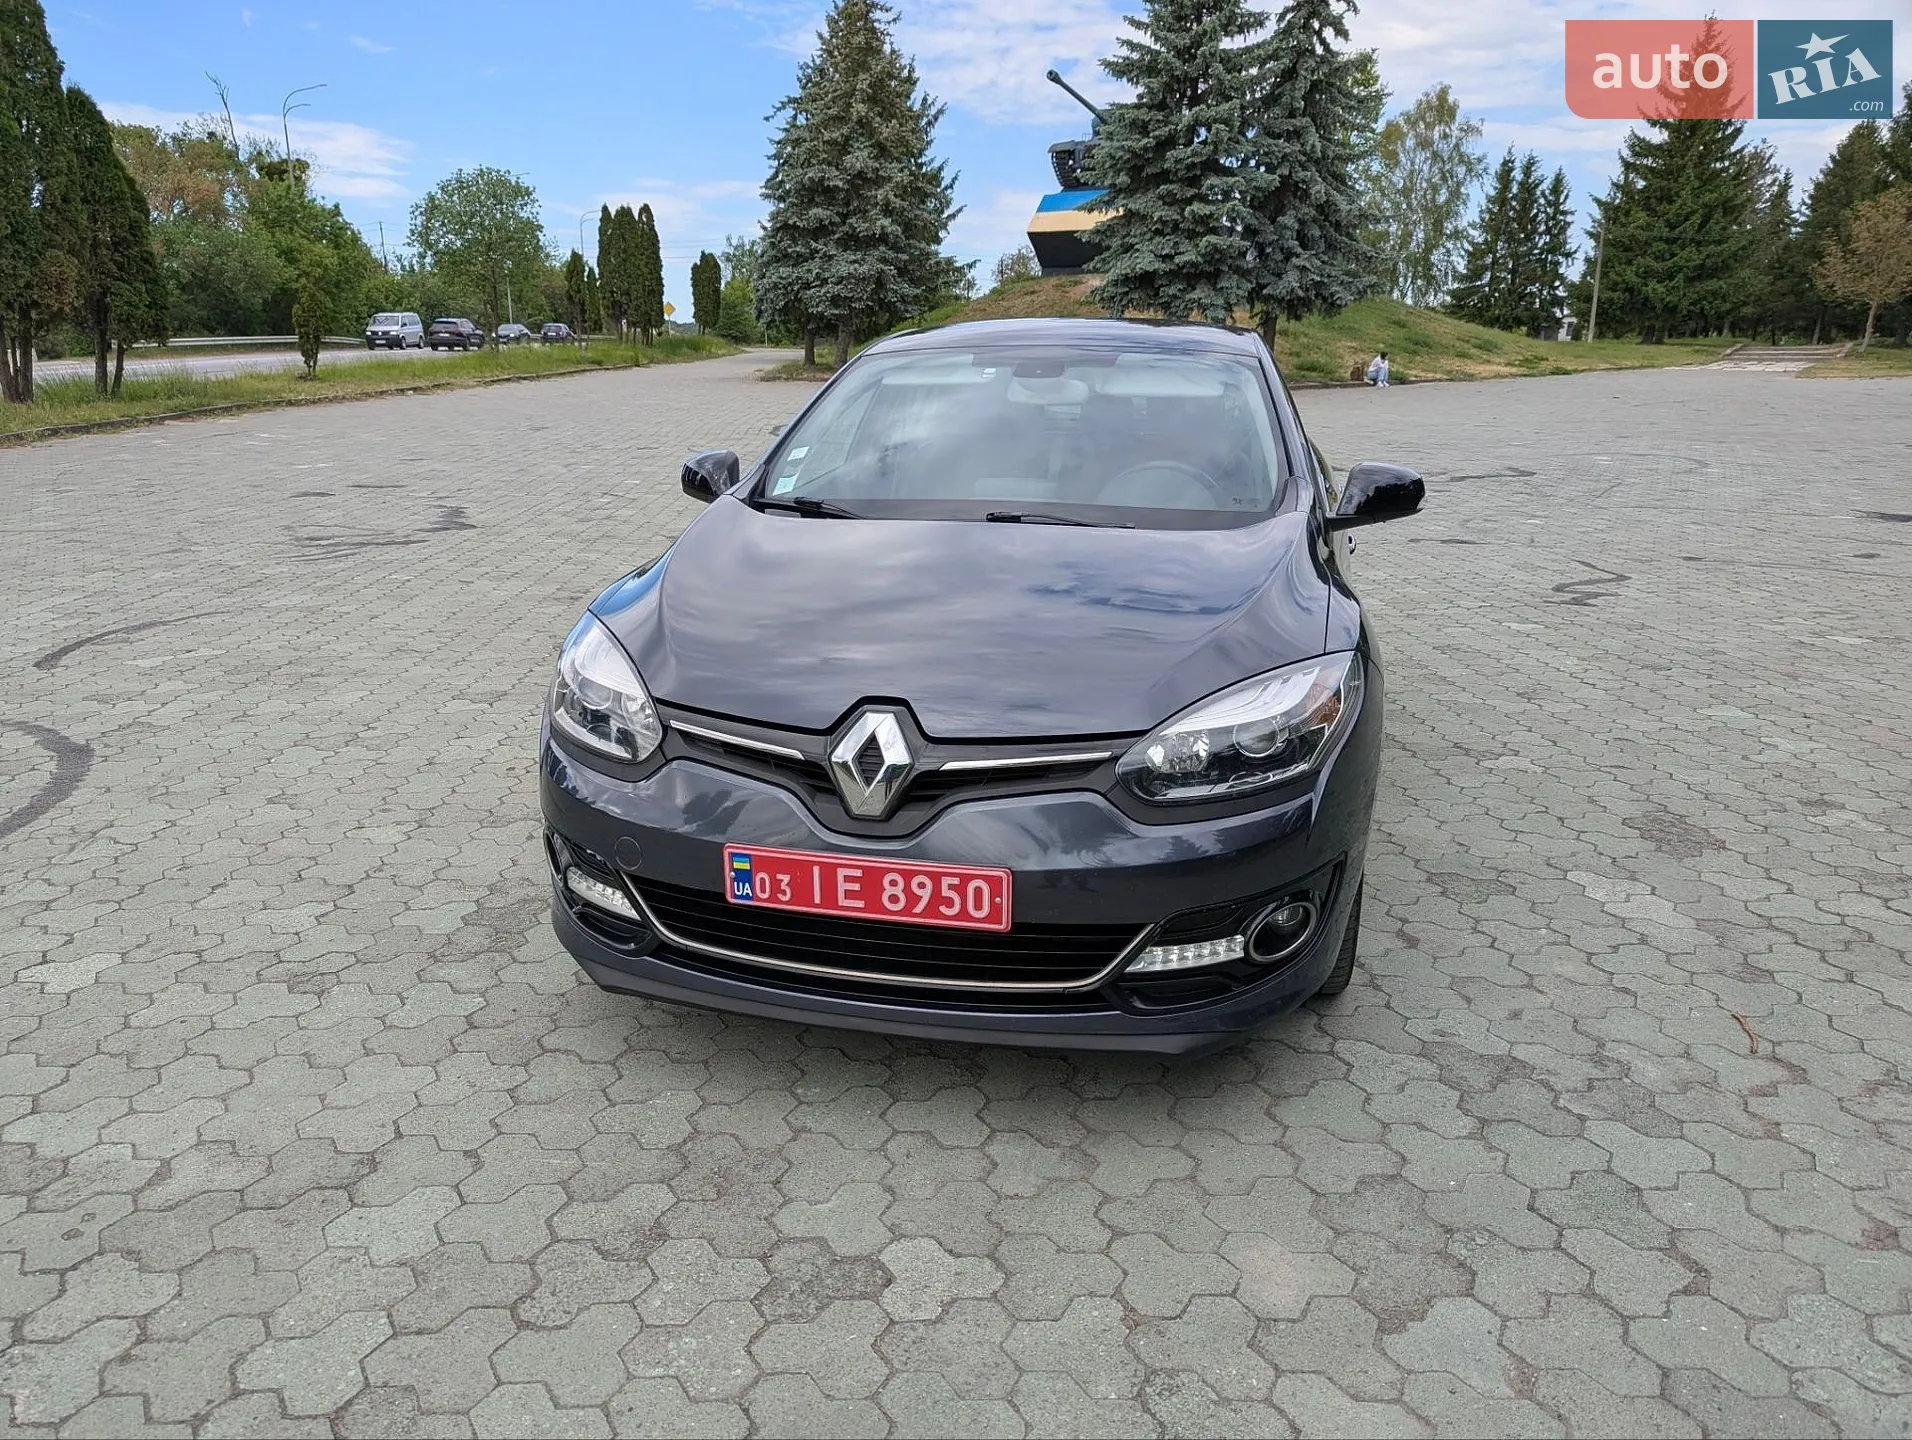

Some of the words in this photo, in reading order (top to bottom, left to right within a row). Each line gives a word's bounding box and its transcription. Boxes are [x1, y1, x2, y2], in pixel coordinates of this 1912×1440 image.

[734, 881, 753, 897] UA
[755, 872, 792, 902] 03
[812, 865, 865, 908] IE
[881, 871, 991, 919] 8950
